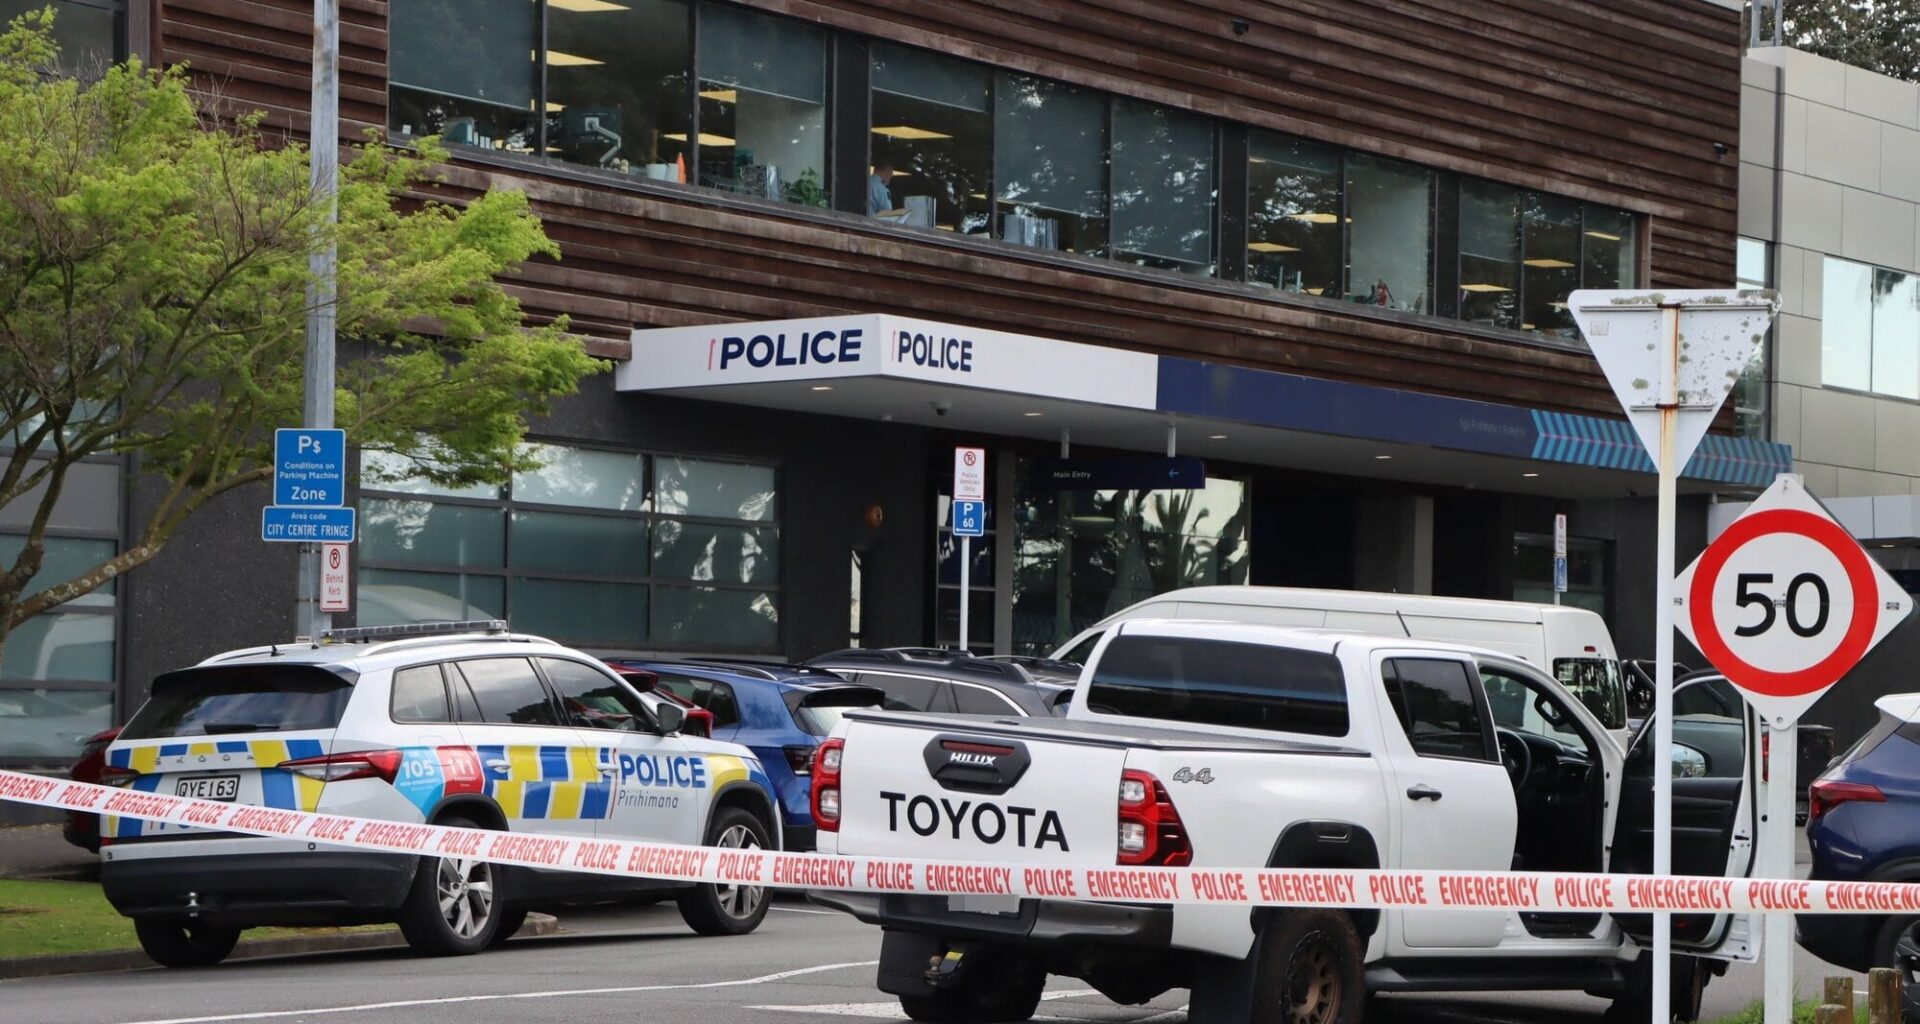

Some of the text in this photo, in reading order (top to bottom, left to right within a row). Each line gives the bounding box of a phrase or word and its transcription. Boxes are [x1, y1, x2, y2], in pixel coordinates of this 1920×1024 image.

[720, 329, 863, 370] POLICE
[898, 330, 973, 372] POLICE
[284, 461, 323, 470] Conditions
[280, 472, 339, 480] Parking Machine
[1072, 471, 1091, 479] Entry
[291, 486, 327, 500] Zone
[291, 512, 327, 520] Area code
[964, 503, 974, 516] P
[962, 517, 974, 528] 60
[267, 524, 350, 537] CITY CENTRE FRINGE
[326, 573, 344, 584] Behind
[328, 587, 341, 596] Kerb
[1734, 572, 1830, 638] 50
[950, 752, 997, 766] HILUX
[403, 760, 435, 779] 105
[447, 758, 475, 776] 111
[619, 754, 706, 788] POLICE
[178, 779, 236, 797] QYE163
[617, 790, 679, 809] Pirihimana
[880, 791, 1070, 852] TOYOTA
[57, 785, 105, 808] POLICE
[103, 790, 180, 818] EMERGENCY
[180, 802, 229, 825] POLICE
[228, 807, 307, 834] EMERGENCY
[306, 817, 354, 841] POLICE
[355, 822, 434, 850] EMERGENCY
[436, 830, 486, 855] POLICE
[488, 835, 569, 865] EMERGENCY
[574, 843, 621, 871] POLICE
[627, 846, 708, 877] EMERGENCY
[717, 852, 763, 882] POLICE
[773, 856, 855, 888] EMERGENCY
[866, 861, 915, 891] POLICE
[926, 864, 1012, 895] EMERGENCY
[1024, 868, 1077, 897] POLICE
[1087, 870, 1180, 901] EMERGENCY
[1191, 872, 1249, 903] POLICE
[1257, 873, 1357, 905] EMERGENCY
[1368, 874, 1428, 907] POLICE
[1439, 875, 1540, 909] EMERGENCY
[1554, 877, 1615, 909] POLICE
[1626, 878, 1733, 910] EMERGENCY
[1748, 880, 1813, 911] POLICE
